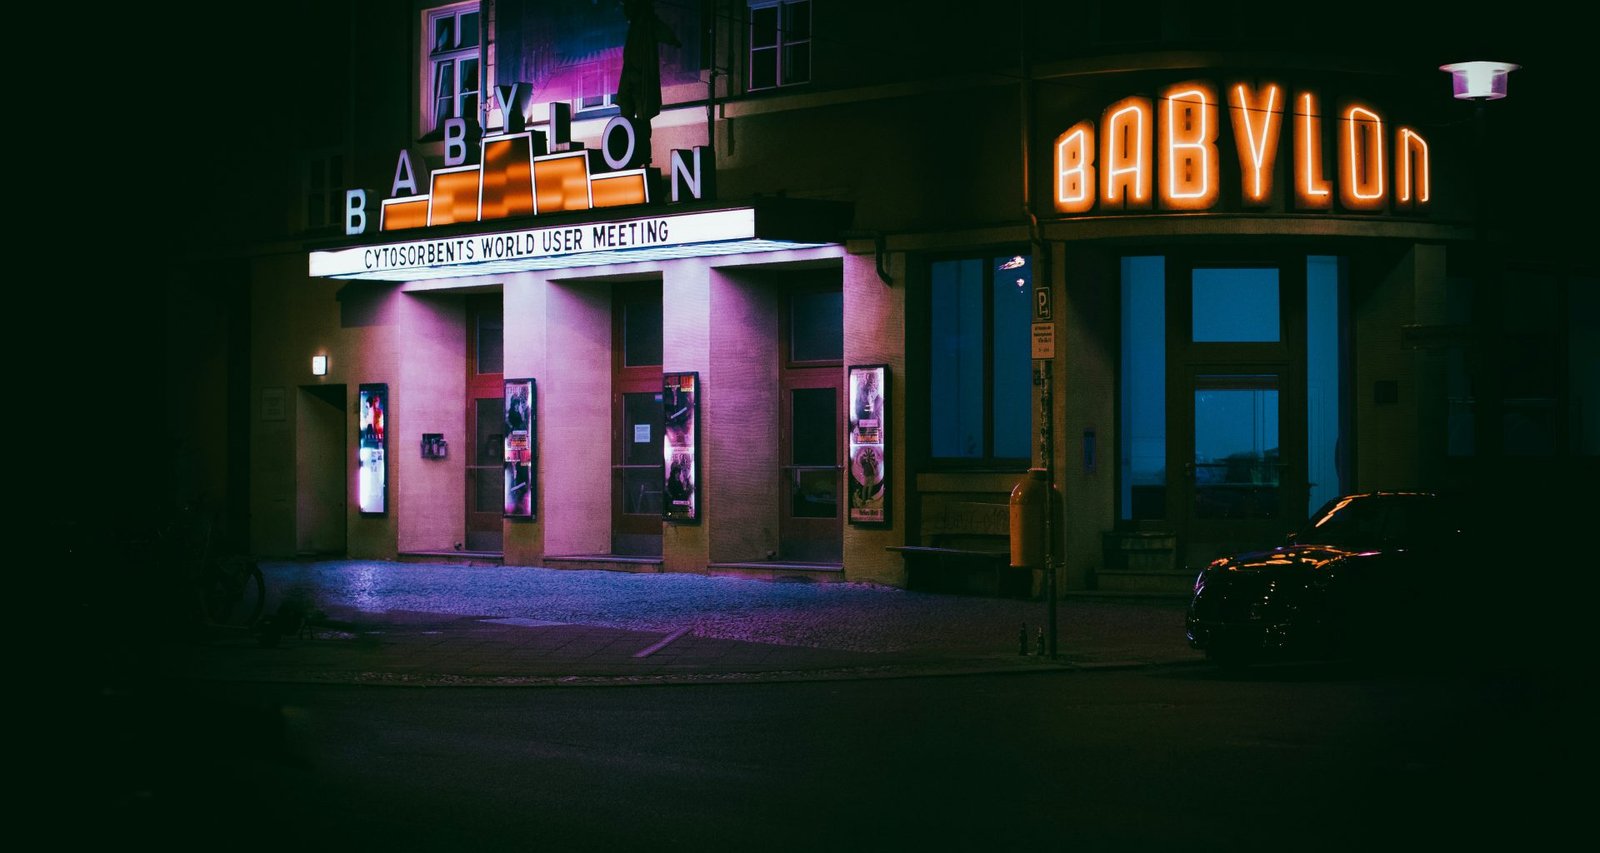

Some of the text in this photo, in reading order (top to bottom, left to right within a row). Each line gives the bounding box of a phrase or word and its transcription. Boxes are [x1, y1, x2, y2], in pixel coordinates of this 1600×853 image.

[345, 82, 703, 235] BABYLON
[1054, 81, 1431, 212] BABYLON
[364, 219, 670, 270] CYTOSORBENTS WORLD USER MEETING
